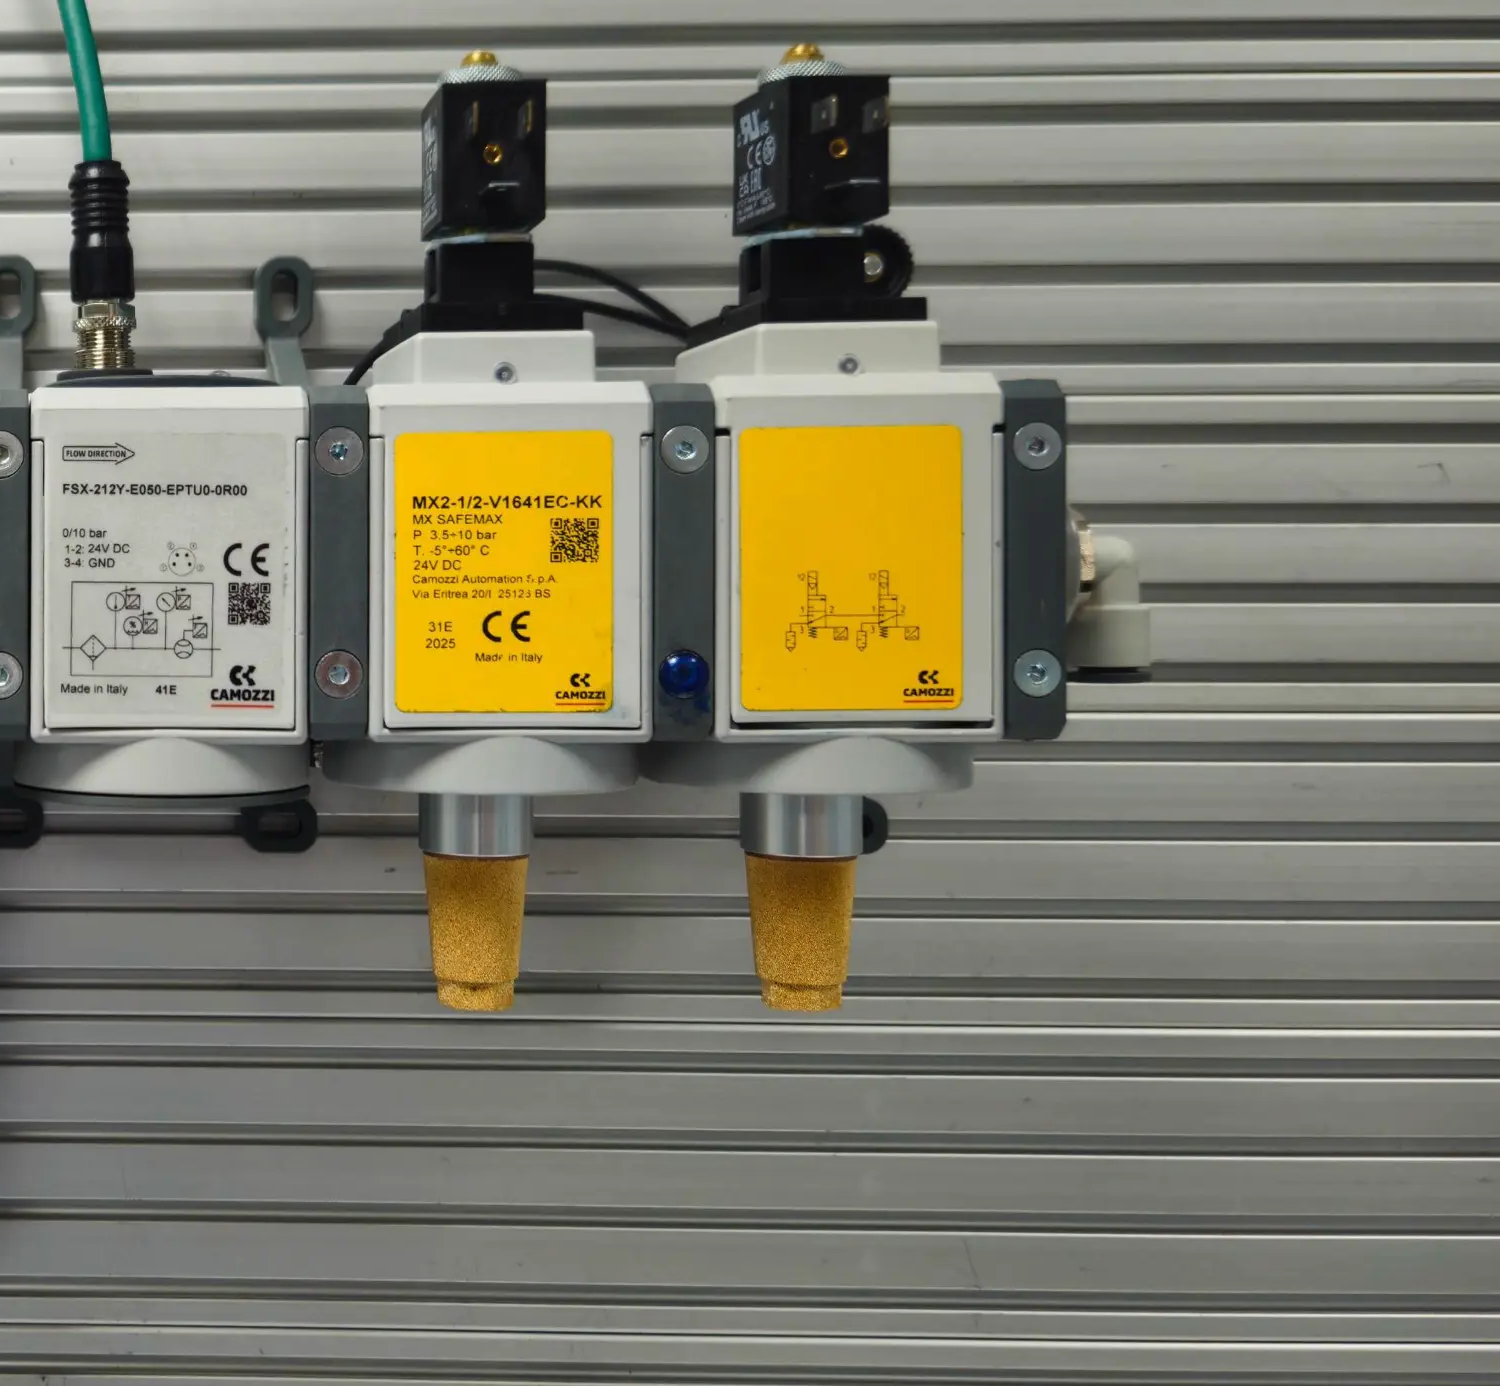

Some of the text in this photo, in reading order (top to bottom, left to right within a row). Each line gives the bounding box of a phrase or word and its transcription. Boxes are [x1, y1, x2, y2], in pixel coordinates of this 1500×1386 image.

[65, 449, 127, 458] FLOW DIRECTION
[62, 483, 248, 496] FSX-212Y-E050-EPTU0-0R00
[412, 494, 603, 510] MX2-1/2-V1641EC-KK
[412, 514, 503, 525] MX SAFEMAX
[62, 527, 107, 539] 0/10 bar
[476, 530, 497, 540] bar
[65, 543, 131, 555] 1-2: 24V DC
[480, 545, 490, 556] C
[64, 558, 116, 568] 3-4: GND
[223, 542, 270, 577] CE
[413, 560, 462, 571] 24V DC
[412, 575, 459, 584] Camozzi
[462, 575, 523, 584] Automation
[412, 589, 430, 599] Via
[433, 589, 468, 599] Eritrea
[535, 589, 552, 599] BS
[428, 621, 453, 632] 31E
[482, 611, 531, 643] CE
[425, 638, 456, 649] 2025
[508, 653, 518, 662] in
[521, 652, 543, 664] Italy
[60, 683, 128, 696] Made in Italy
[155, 684, 177, 695] 41E
[210, 688, 275, 702] CAMOZZI
[903, 688, 955, 697] CAMOZZI
[555, 691, 606, 700] CAMOZZI
